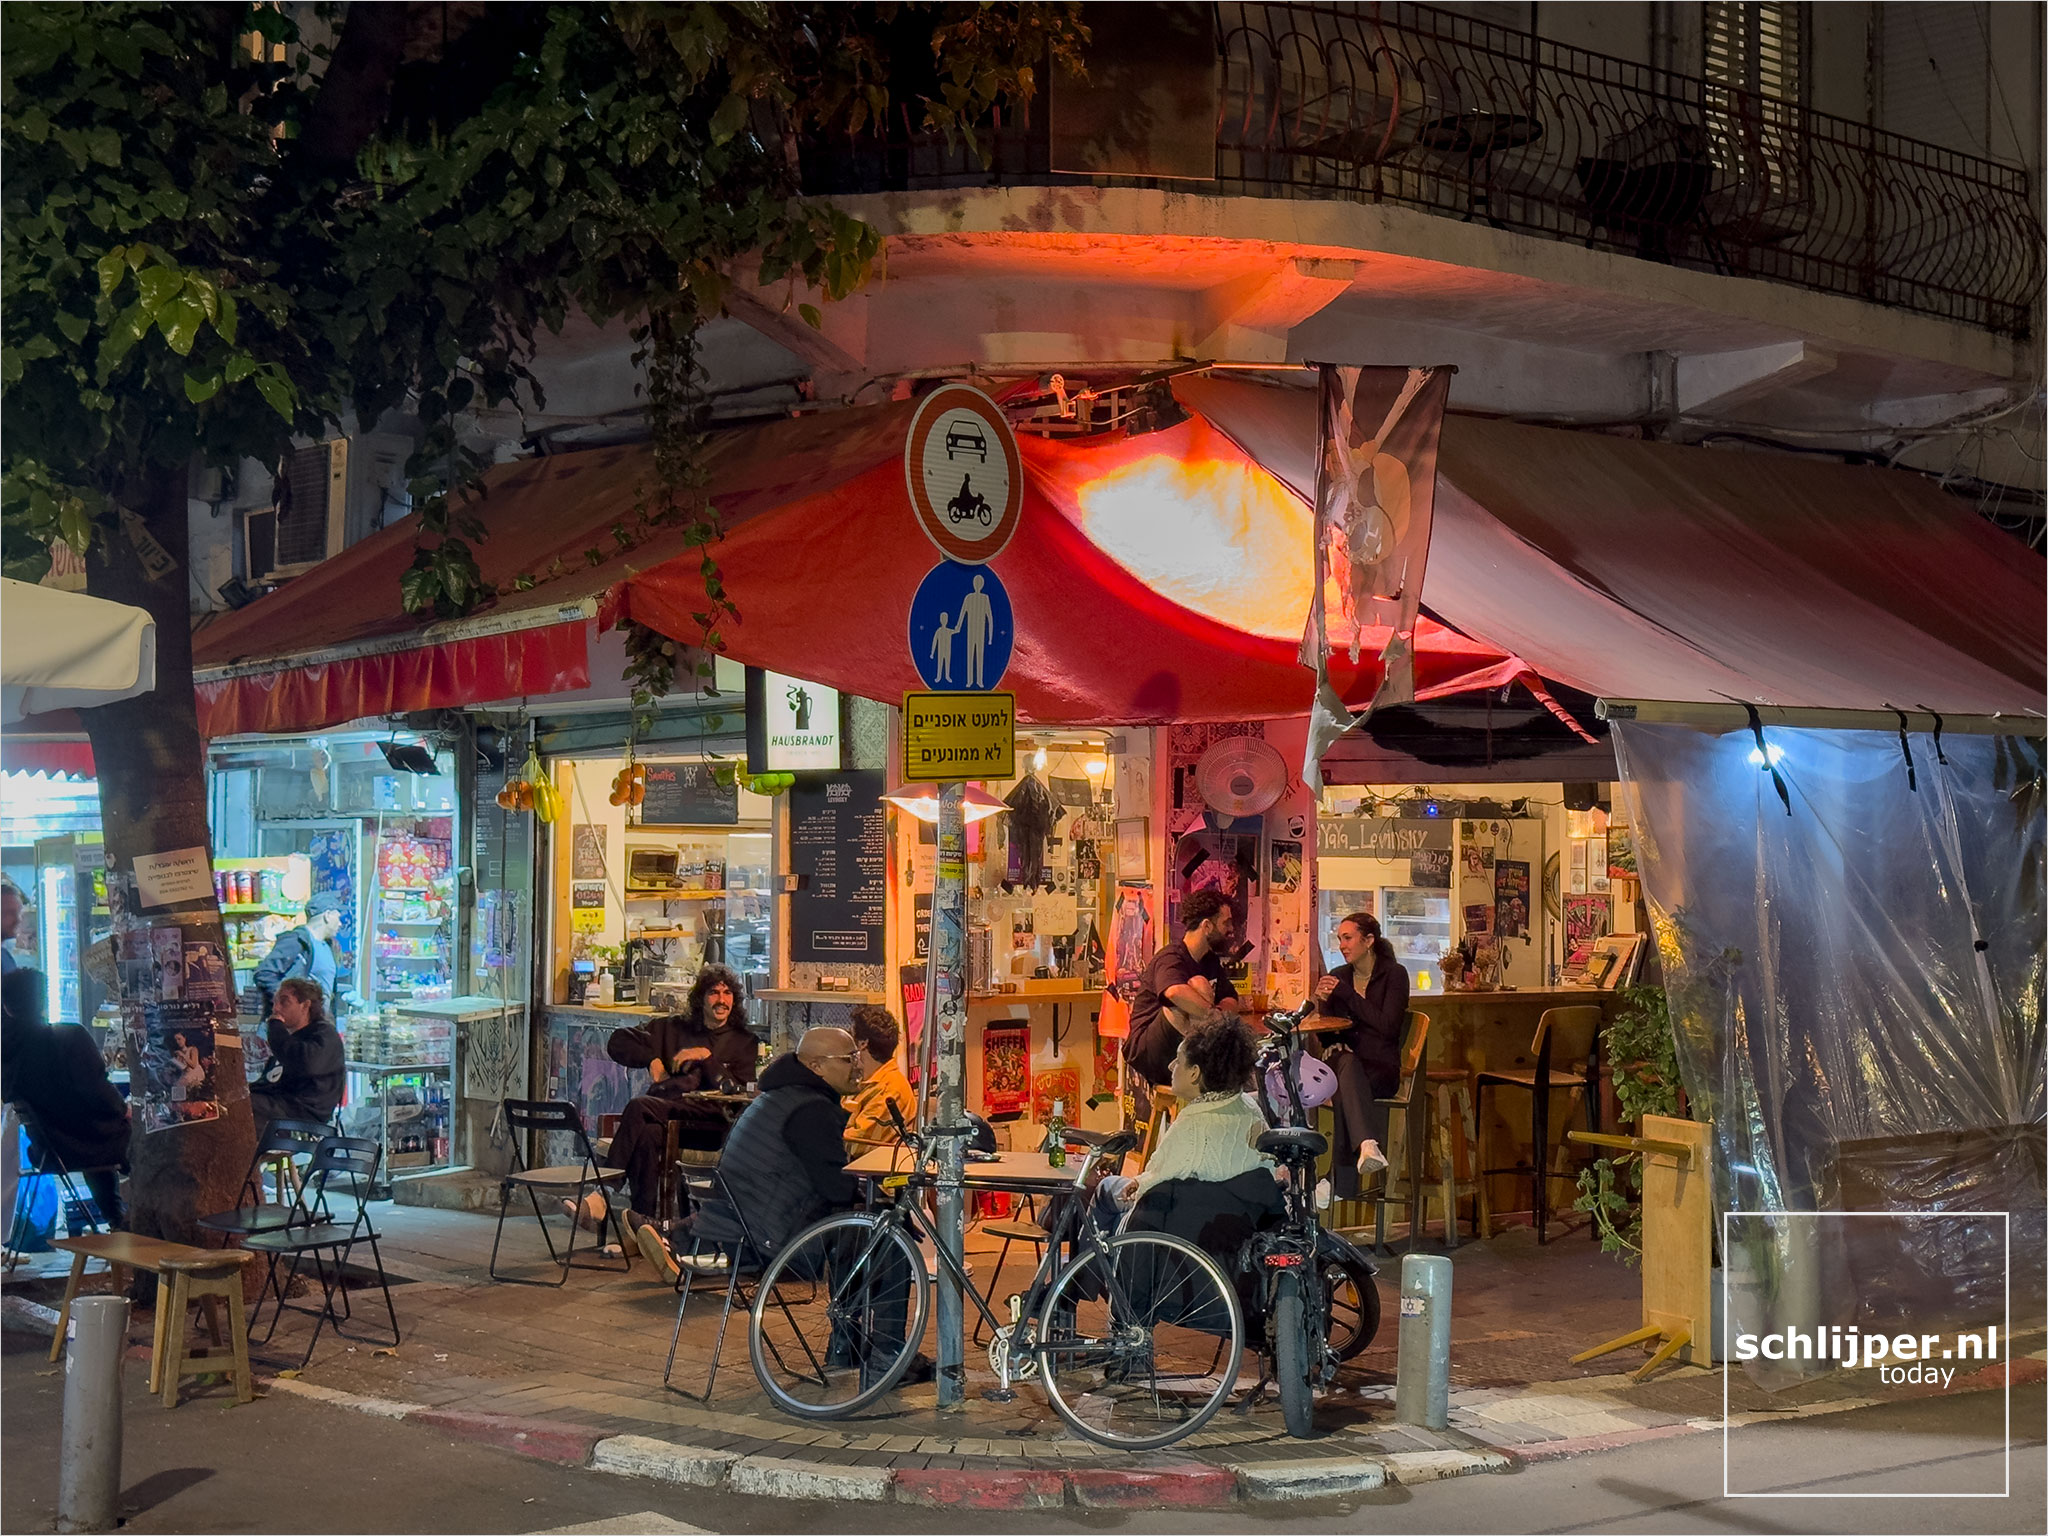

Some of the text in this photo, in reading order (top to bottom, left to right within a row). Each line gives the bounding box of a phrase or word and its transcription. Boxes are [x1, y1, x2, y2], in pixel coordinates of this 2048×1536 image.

[914, 709, 1008, 729] למעט אופניים
[771, 735, 834, 747] HAUSBRANDT
[921, 746, 1002, 763] לא ממונעים
